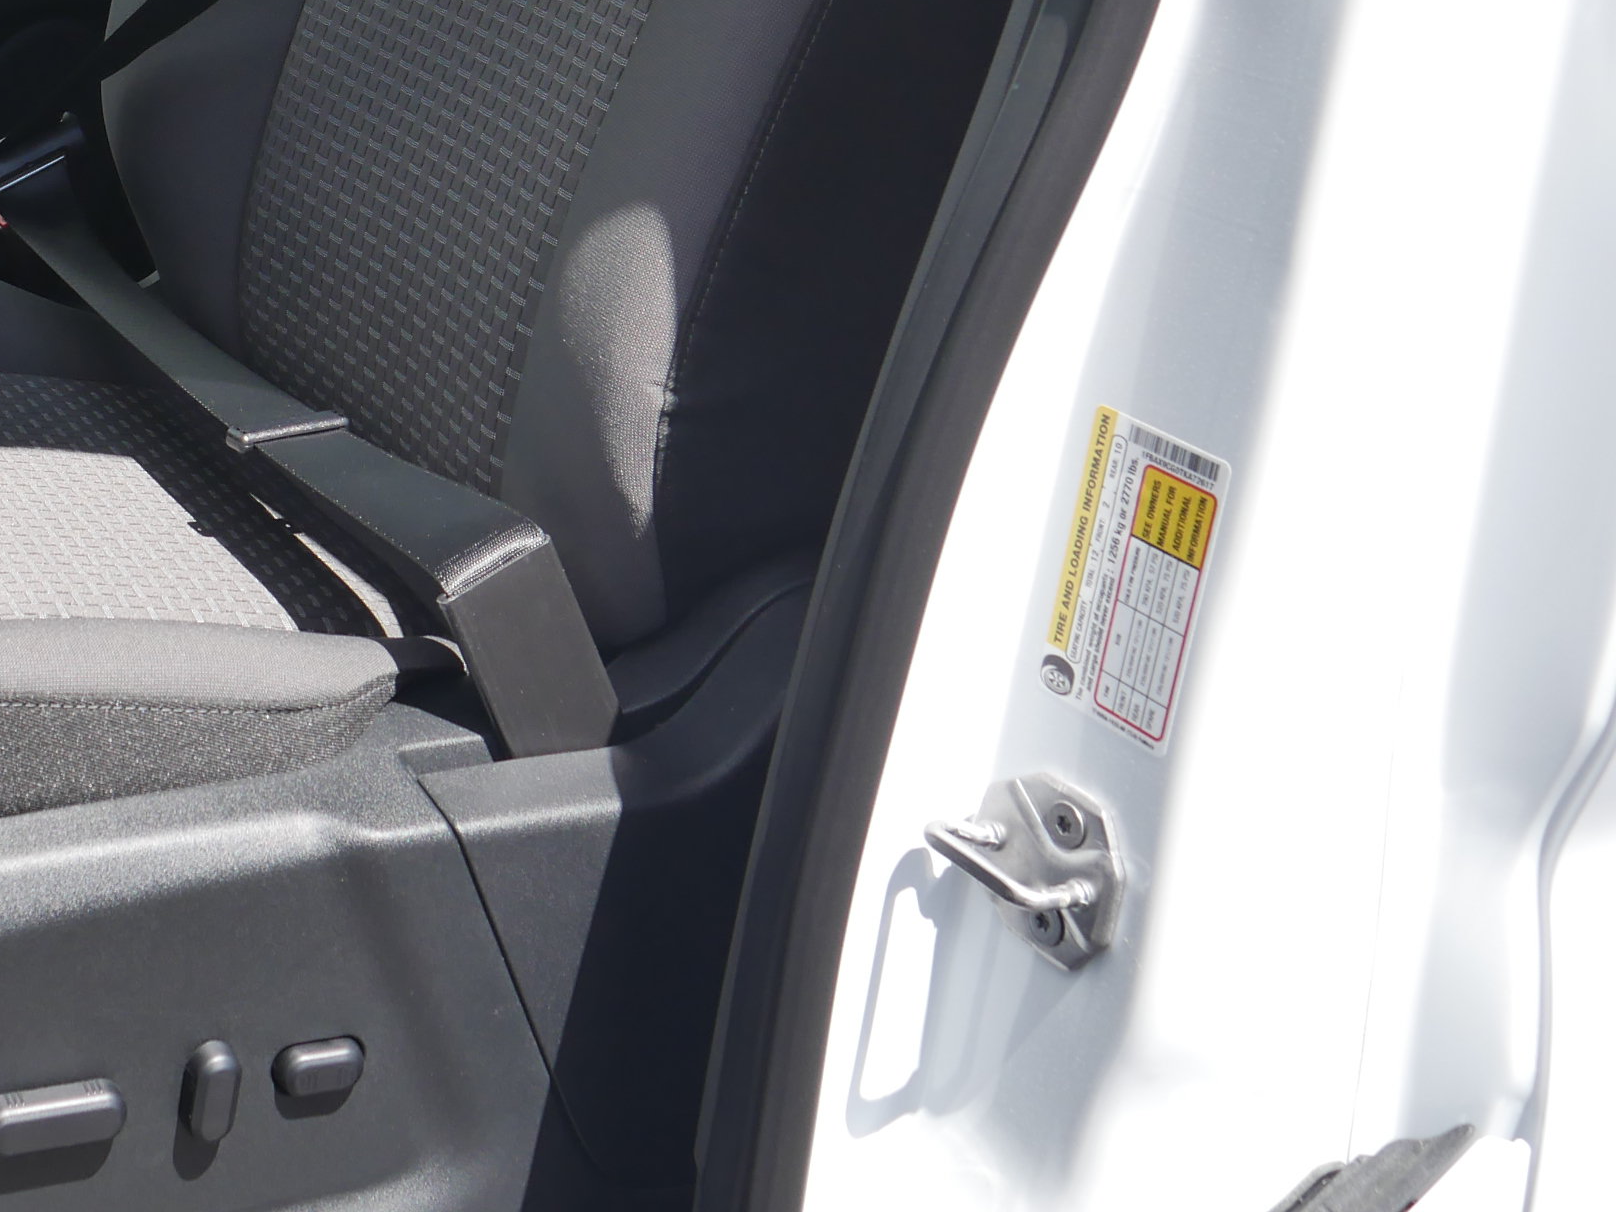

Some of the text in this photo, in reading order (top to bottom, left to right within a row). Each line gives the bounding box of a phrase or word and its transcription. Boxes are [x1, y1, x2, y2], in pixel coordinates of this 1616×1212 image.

[1119, 474, 1134, 506] 2770
[1141, 477, 1162, 541] SEE OWNERS
[1053, 412, 1111, 645] TIRE AND LOADING INFORMATION
[1113, 519, 1126, 537] kg
[1117, 506, 1128, 521] or
[1155, 484, 1177, 548] MANUAL FOR
[1171, 494, 1192, 552] ADDITIONAL
[1185, 494, 1209, 564] INFORMATION
[1106, 535, 1120, 565] 1256
[1074, 598, 1088, 632] CAPACITY
